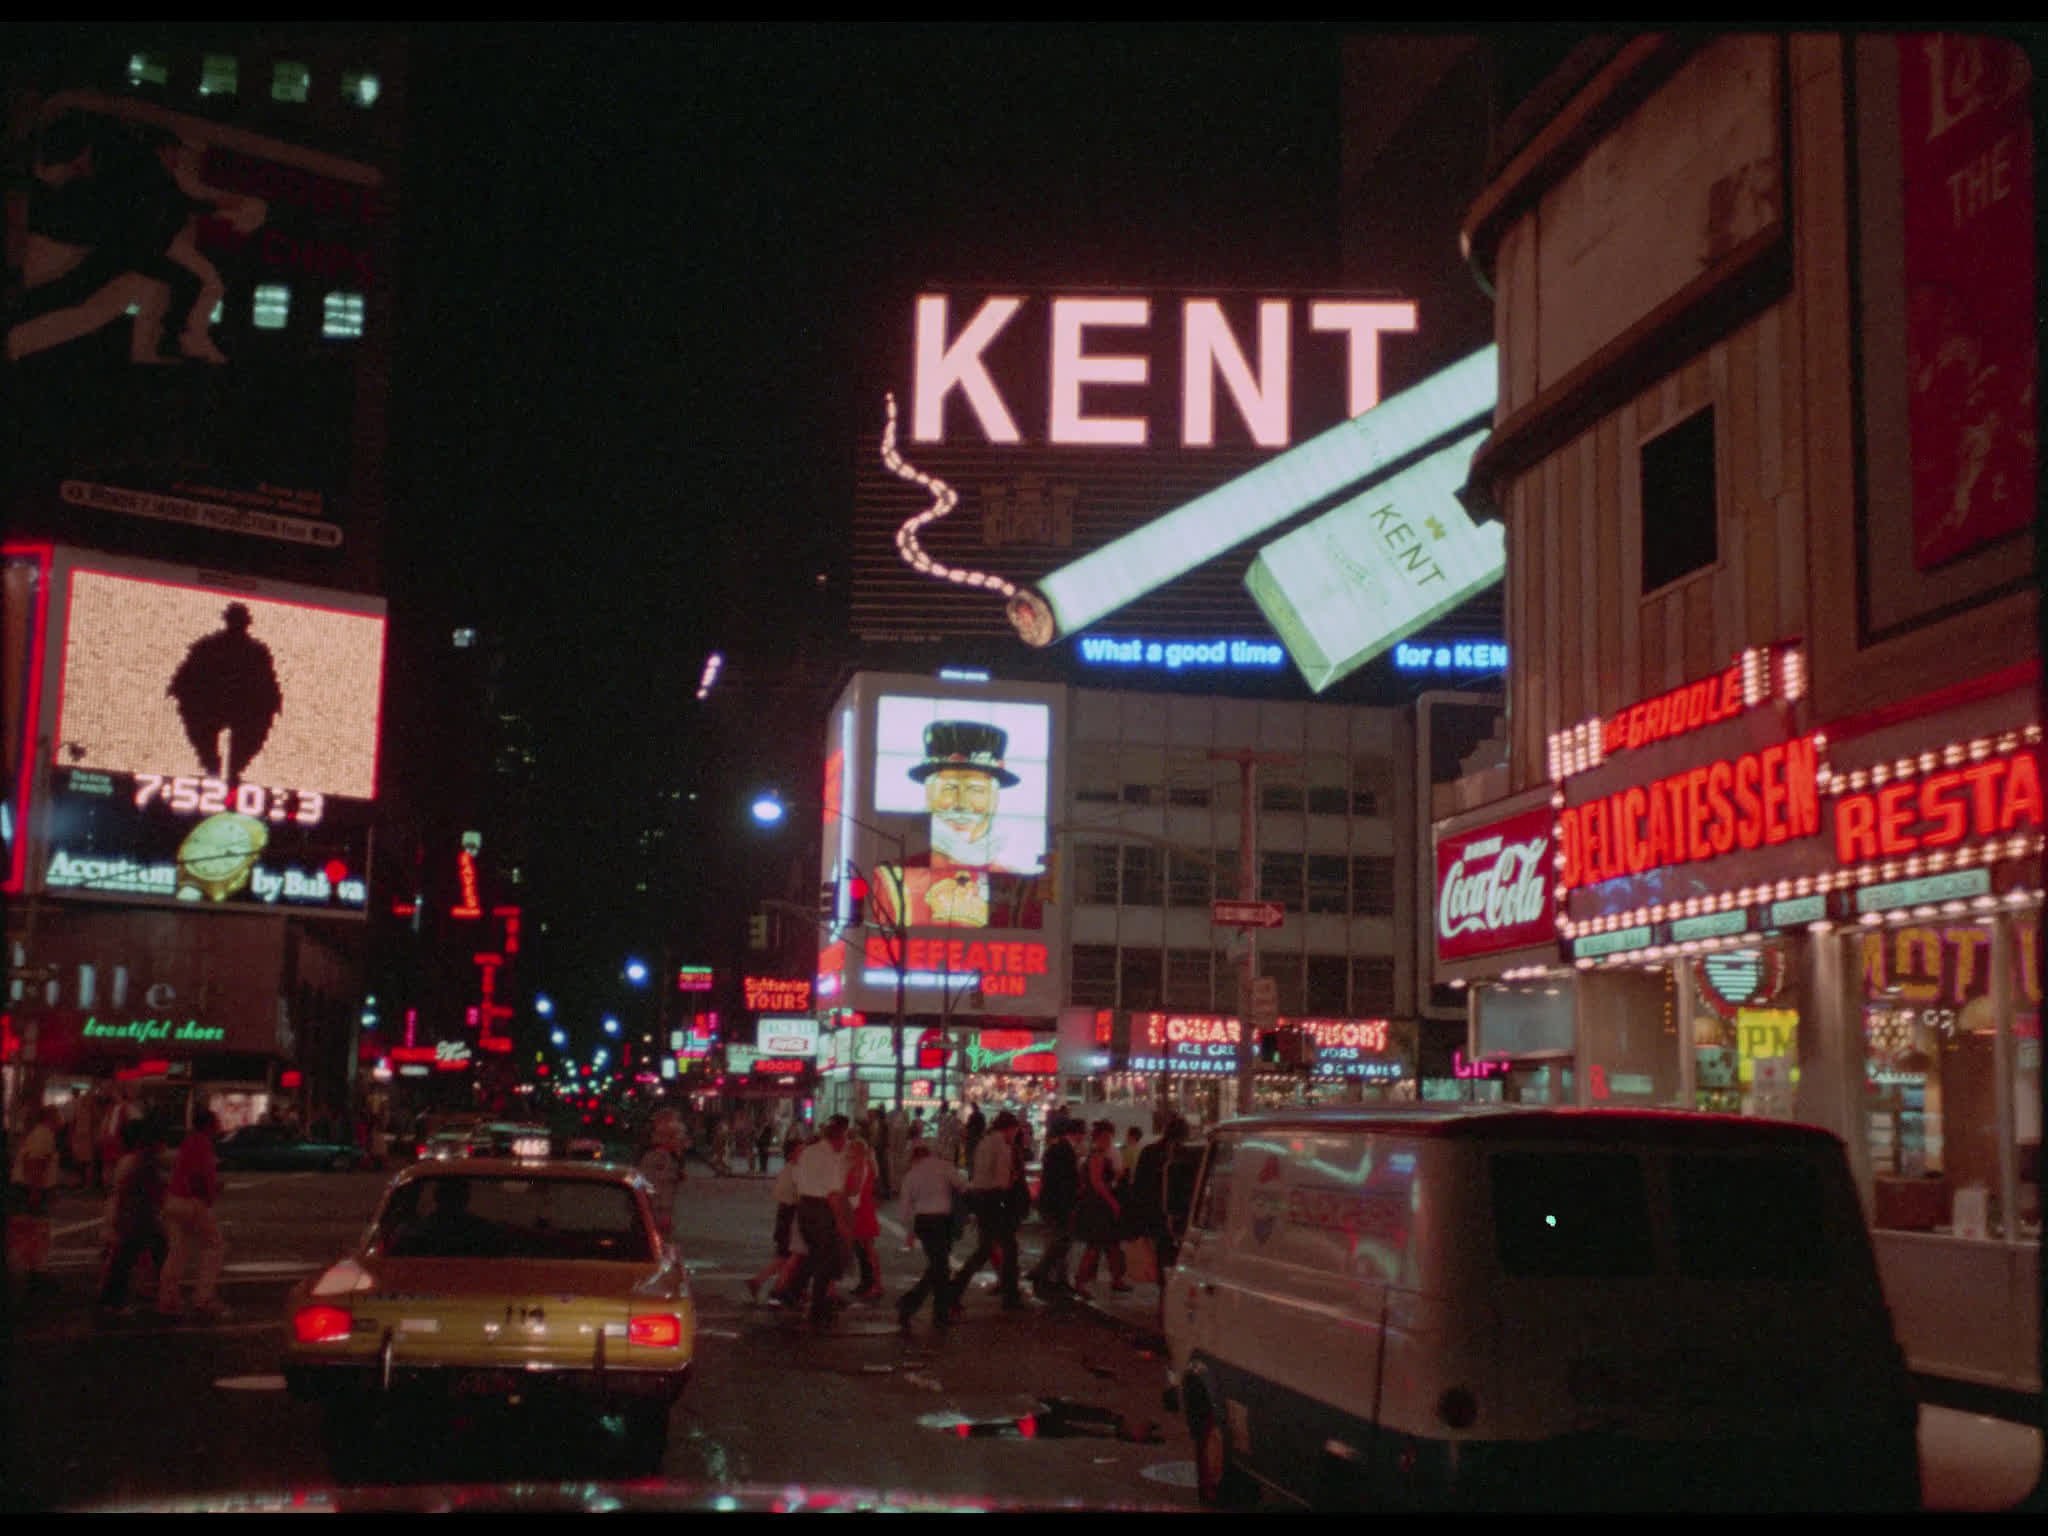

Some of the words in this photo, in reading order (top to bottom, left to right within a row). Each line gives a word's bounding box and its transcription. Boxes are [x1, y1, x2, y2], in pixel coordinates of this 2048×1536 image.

[911, 294, 1418, 447] KENT
[1369, 503, 1446, 587] KENT
[1083, 639, 1142, 662] What
[1146, 644, 1162, 662] a
[1165, 642, 1226, 668] good
[1231, 641, 1283, 664] time
[1397, 643, 1433, 667] for
[1435, 648, 1451, 667] a
[1626, 662, 1744, 751] GRIDDLE
[1562, 735, 1819, 891] DELICATESSEN
[252, 867, 283, 902] by
[285, 871, 366, 901] Bulva
[981, 973, 1027, 996] GIN
[746, 992, 809, 1011] TOURS
[83, 1016, 171, 1043] beautiful
[174, 1019, 225, 1041] shoes
[1134, 1056, 1238, 1071] RESTAURAN
